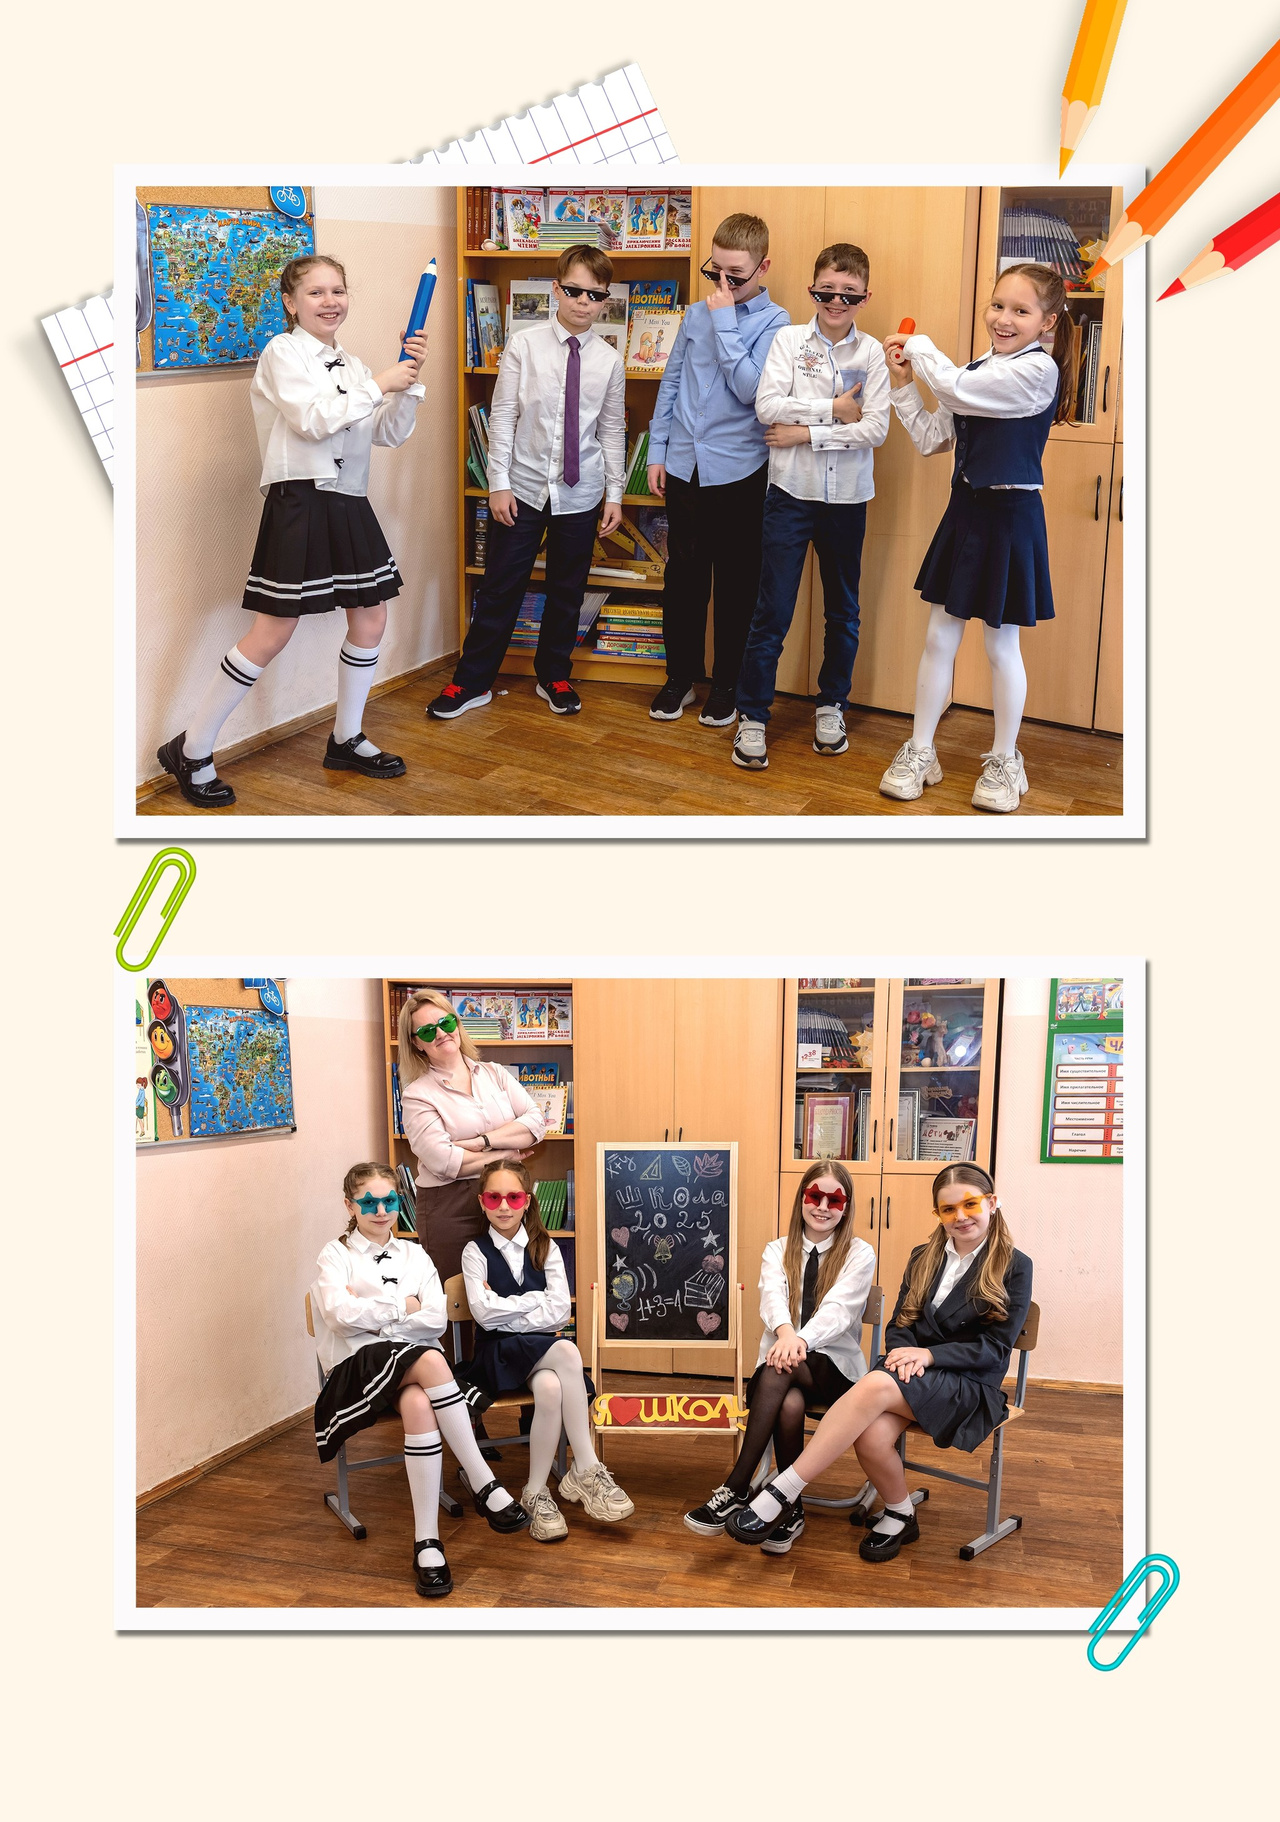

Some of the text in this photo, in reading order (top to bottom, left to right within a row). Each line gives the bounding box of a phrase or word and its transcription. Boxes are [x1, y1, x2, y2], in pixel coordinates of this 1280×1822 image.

[217, 217, 261, 228] КАРТА МИРА
[629, 294, 672, 305] ИВОТНЫЕ
[519, 1074, 555, 1082] ИВОТНЫЕ
